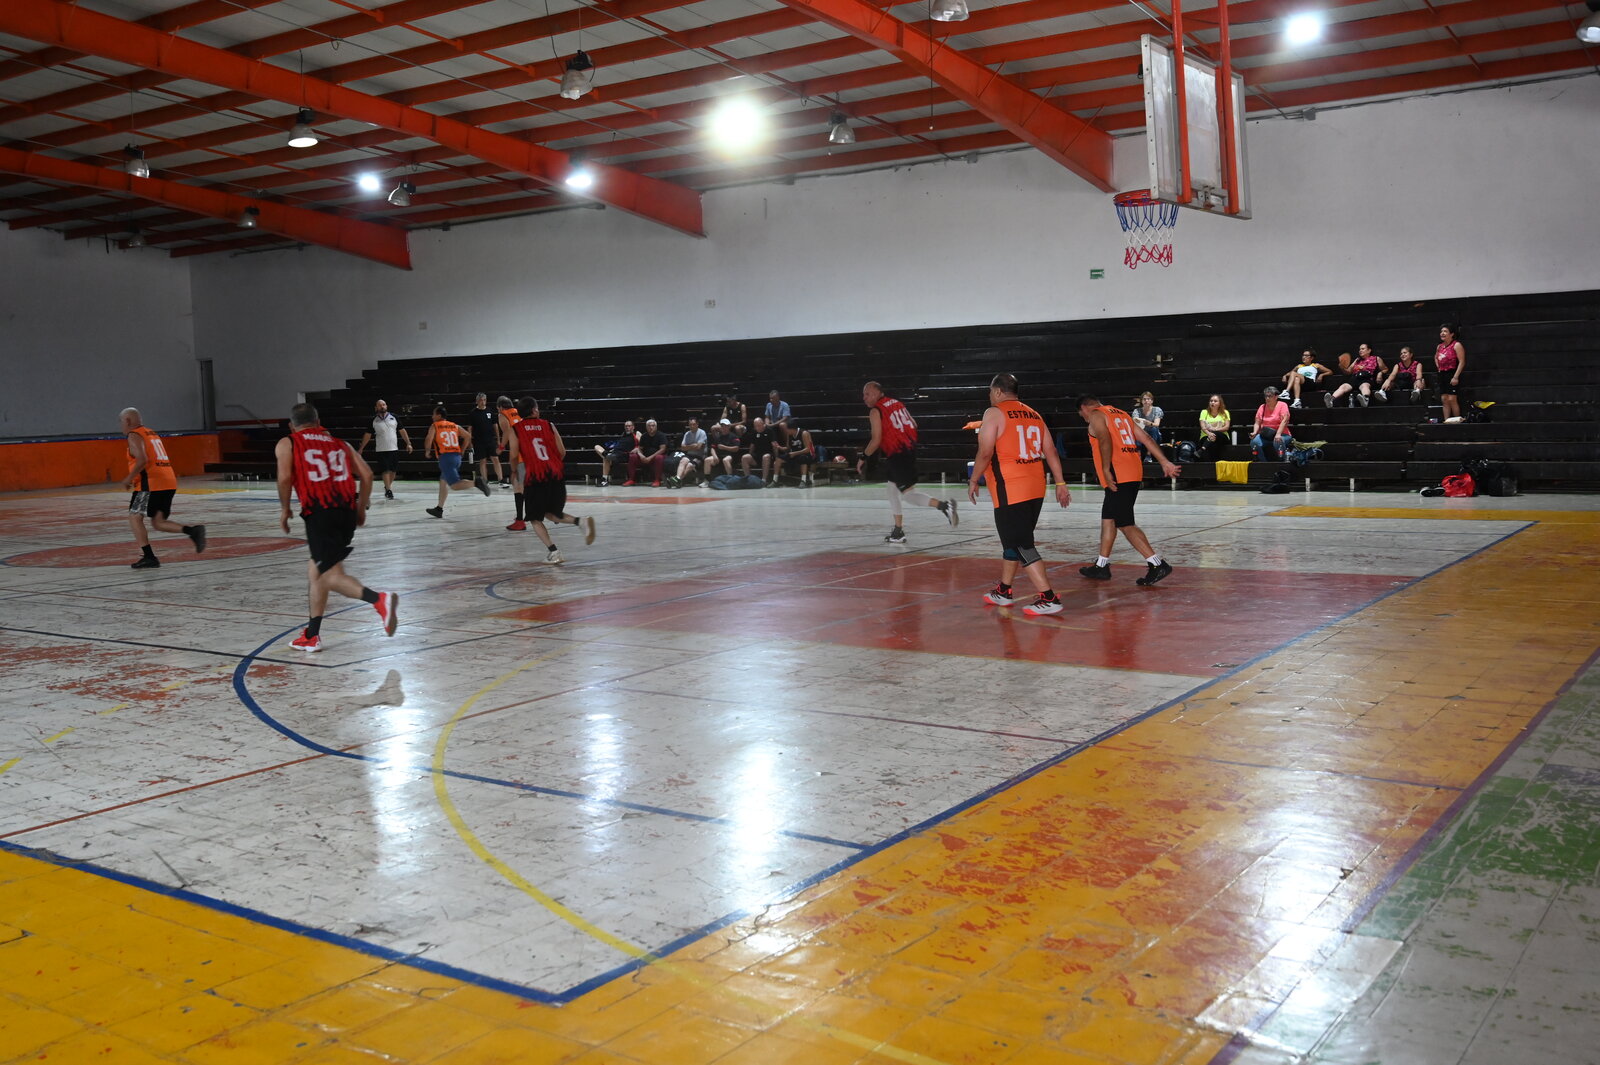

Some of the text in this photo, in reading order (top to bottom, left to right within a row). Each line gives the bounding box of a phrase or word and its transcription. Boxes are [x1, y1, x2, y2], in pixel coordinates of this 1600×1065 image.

[150, 438, 169, 461] 10
[440, 431, 459, 448] 30
[532, 437, 549, 461] 6
[1016, 424, 1042, 460] 13
[304, 449, 349, 482] 59
